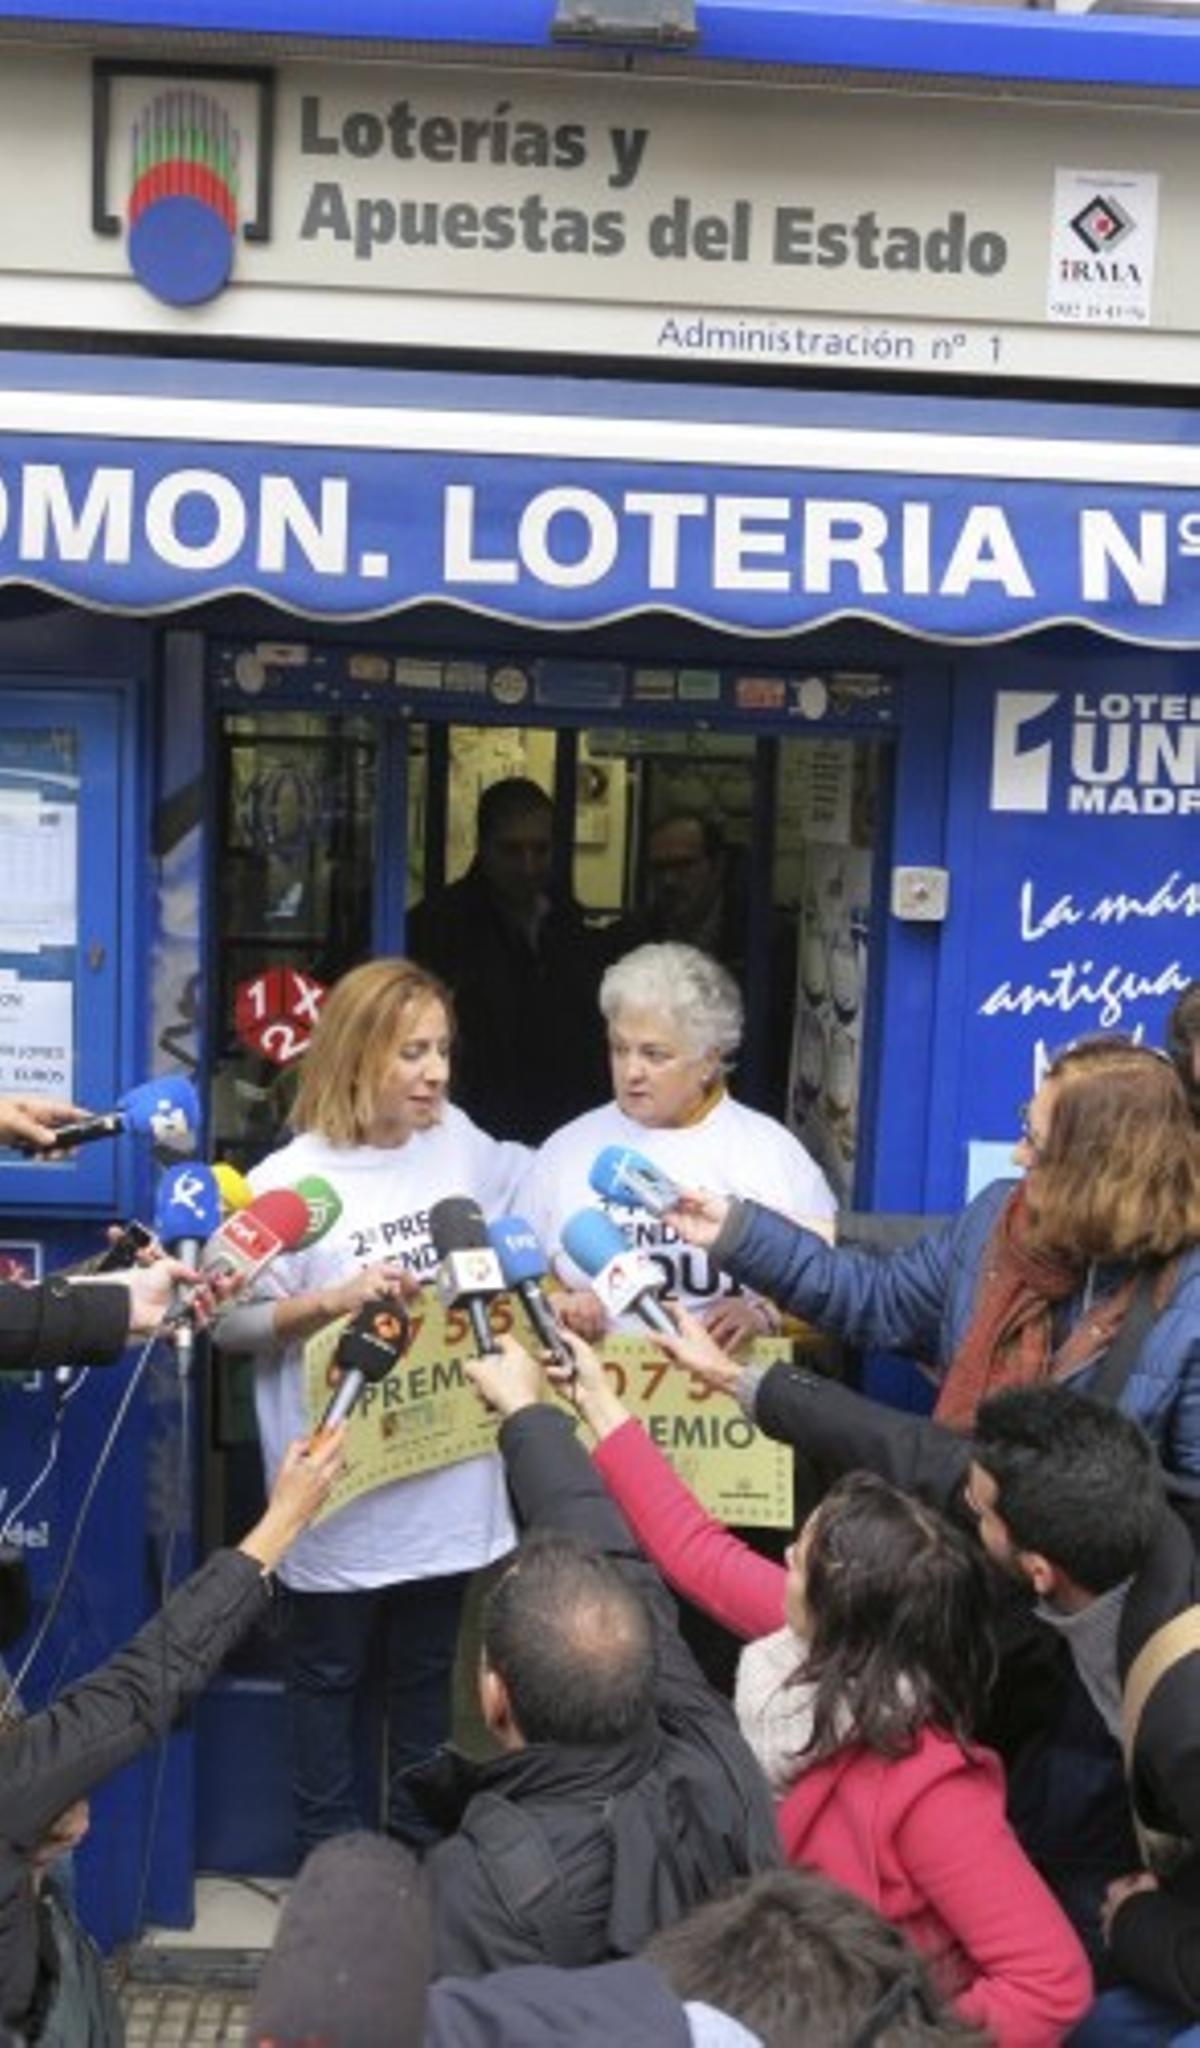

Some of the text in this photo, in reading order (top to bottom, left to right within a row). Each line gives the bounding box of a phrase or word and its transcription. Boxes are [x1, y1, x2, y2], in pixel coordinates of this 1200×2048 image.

[302, 97, 650, 188] Loterías y
[300, 183, 1008, 276] Apuestas del Estado
[657, 318, 1001, 363] Administración nº 1
[0, 464, 390, 579] MON.
[443, 485, 1036, 599] LOTERIA
[1074, 693, 1200, 721] LOTE
[1020, 870, 1200, 942] La más
[977, 960, 1192, 1028] antigua
[647, 1414, 756, 1450] EMIO
